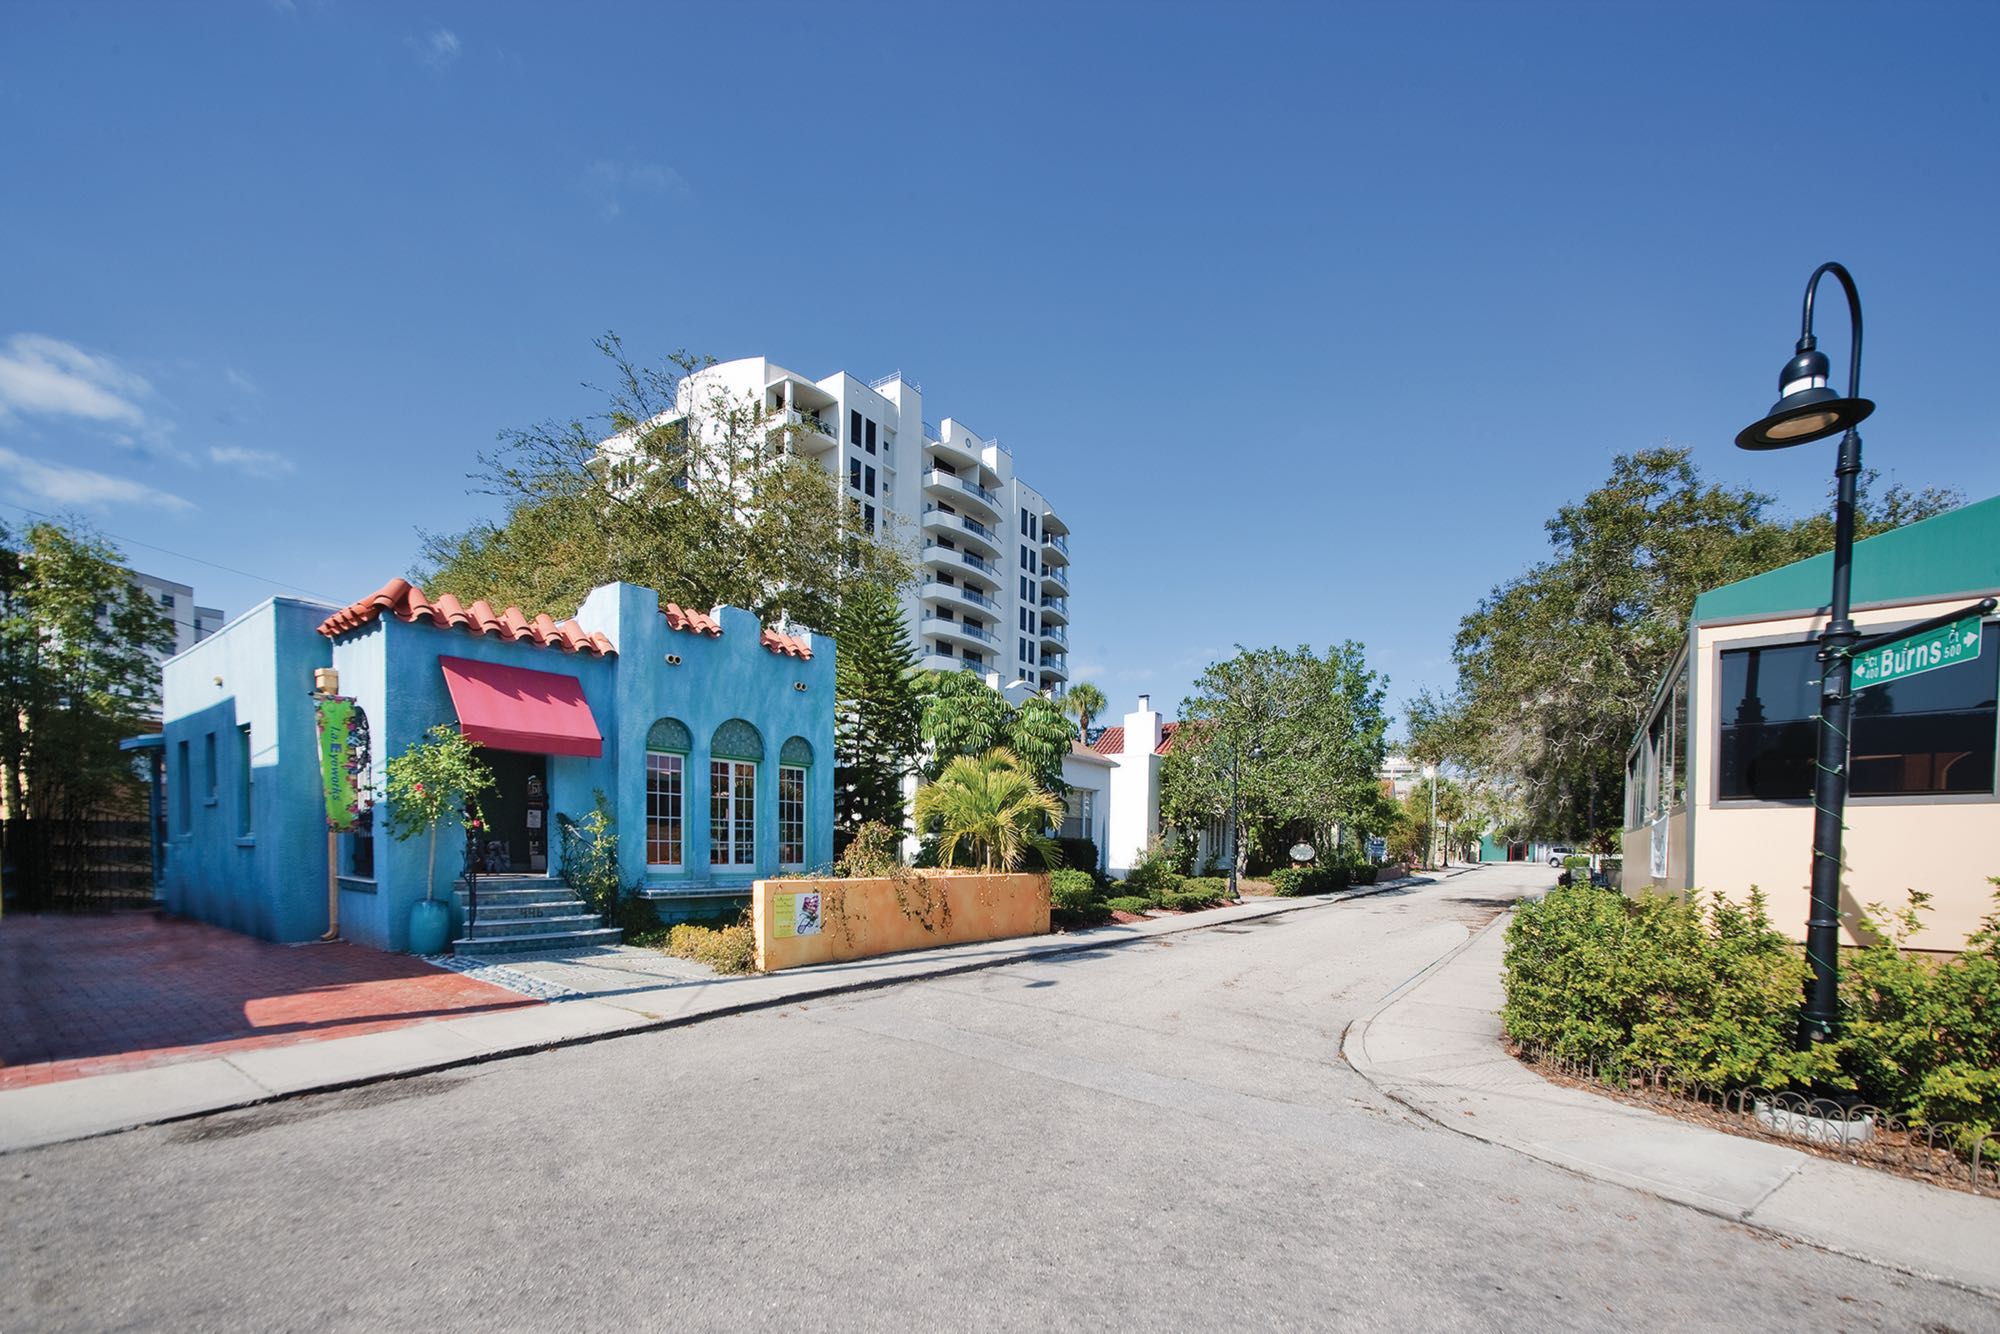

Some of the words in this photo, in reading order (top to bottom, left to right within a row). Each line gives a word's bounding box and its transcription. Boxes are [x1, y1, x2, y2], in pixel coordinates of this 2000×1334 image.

[1944, 643, 1961, 658] 500
[1880, 641, 1942, 678] Burns
[1865, 667, 1879, 678] 400
